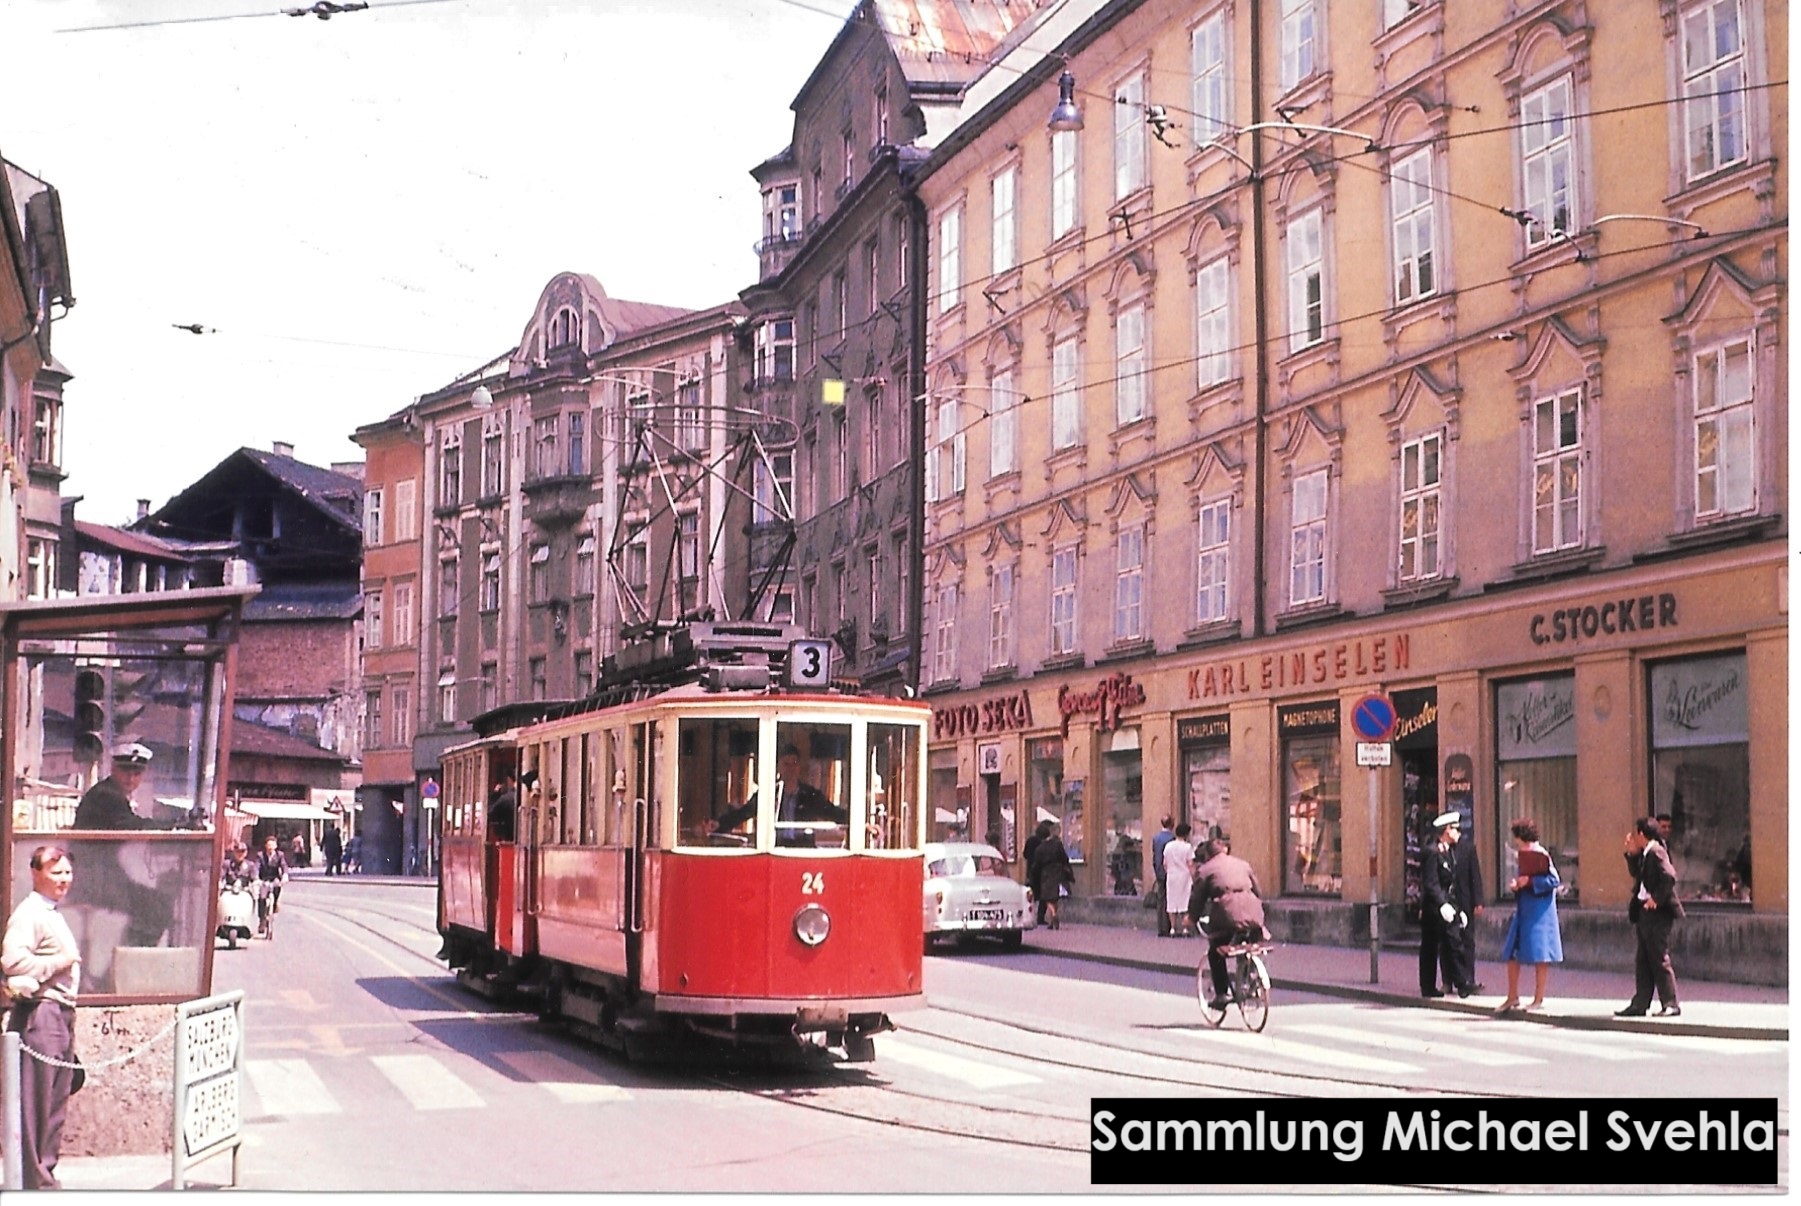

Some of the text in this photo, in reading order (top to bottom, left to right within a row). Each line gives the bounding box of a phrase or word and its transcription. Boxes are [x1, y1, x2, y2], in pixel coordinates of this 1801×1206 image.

[1529, 592, 1679, 646] C.STOCKER
[801, 646, 820, 678] 3
[1187, 633, 1410, 700] KARL EINSELEN
[934, 688, 1034, 739] FOTO SEKA
[1181, 719, 1229, 740] SCHALLPLATTEN
[1282, 708, 1336, 729] MAGNETOPHONE
[801, 871, 825, 895] 24
[187, 1014, 233, 1050] SALZBURG
[193, 1079, 235, 1114] ARLBERG
